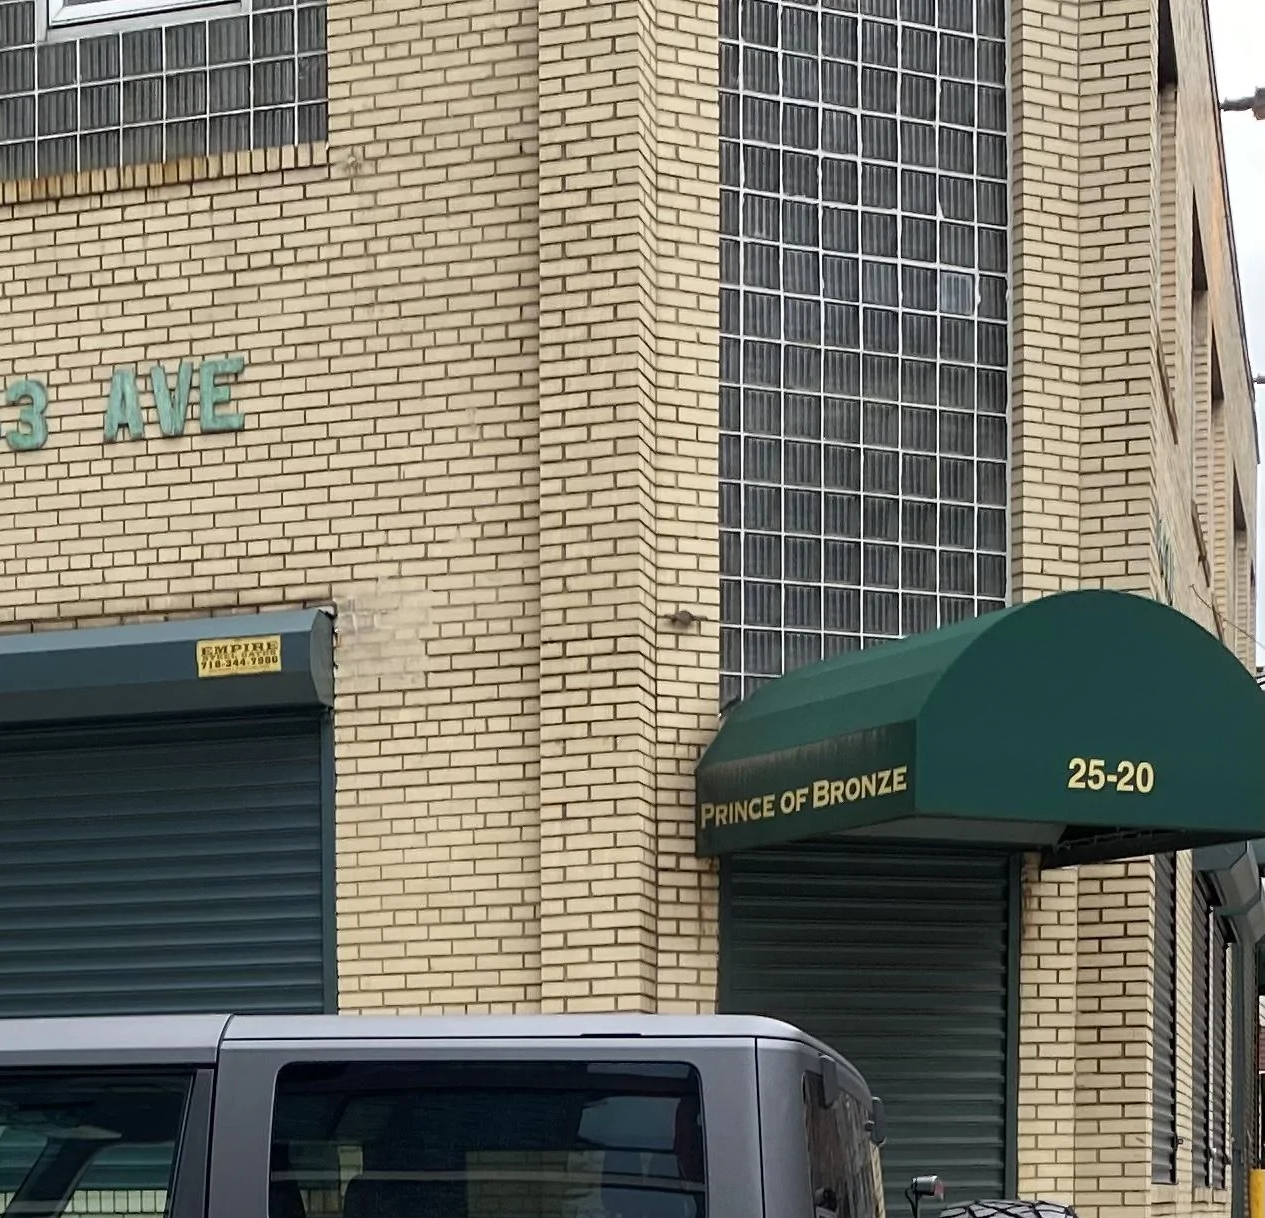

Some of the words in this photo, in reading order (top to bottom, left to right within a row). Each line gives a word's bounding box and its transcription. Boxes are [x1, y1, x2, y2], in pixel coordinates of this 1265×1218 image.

[103, 356, 246, 443] AVE
[201, 641, 278, 655] EMPIRE
[700, 794, 776, 829] PRINCE
[780, 786, 809, 815] OF
[812, 764, 908, 808] BRONZE
[1067, 757, 1155, 793] 25-20
